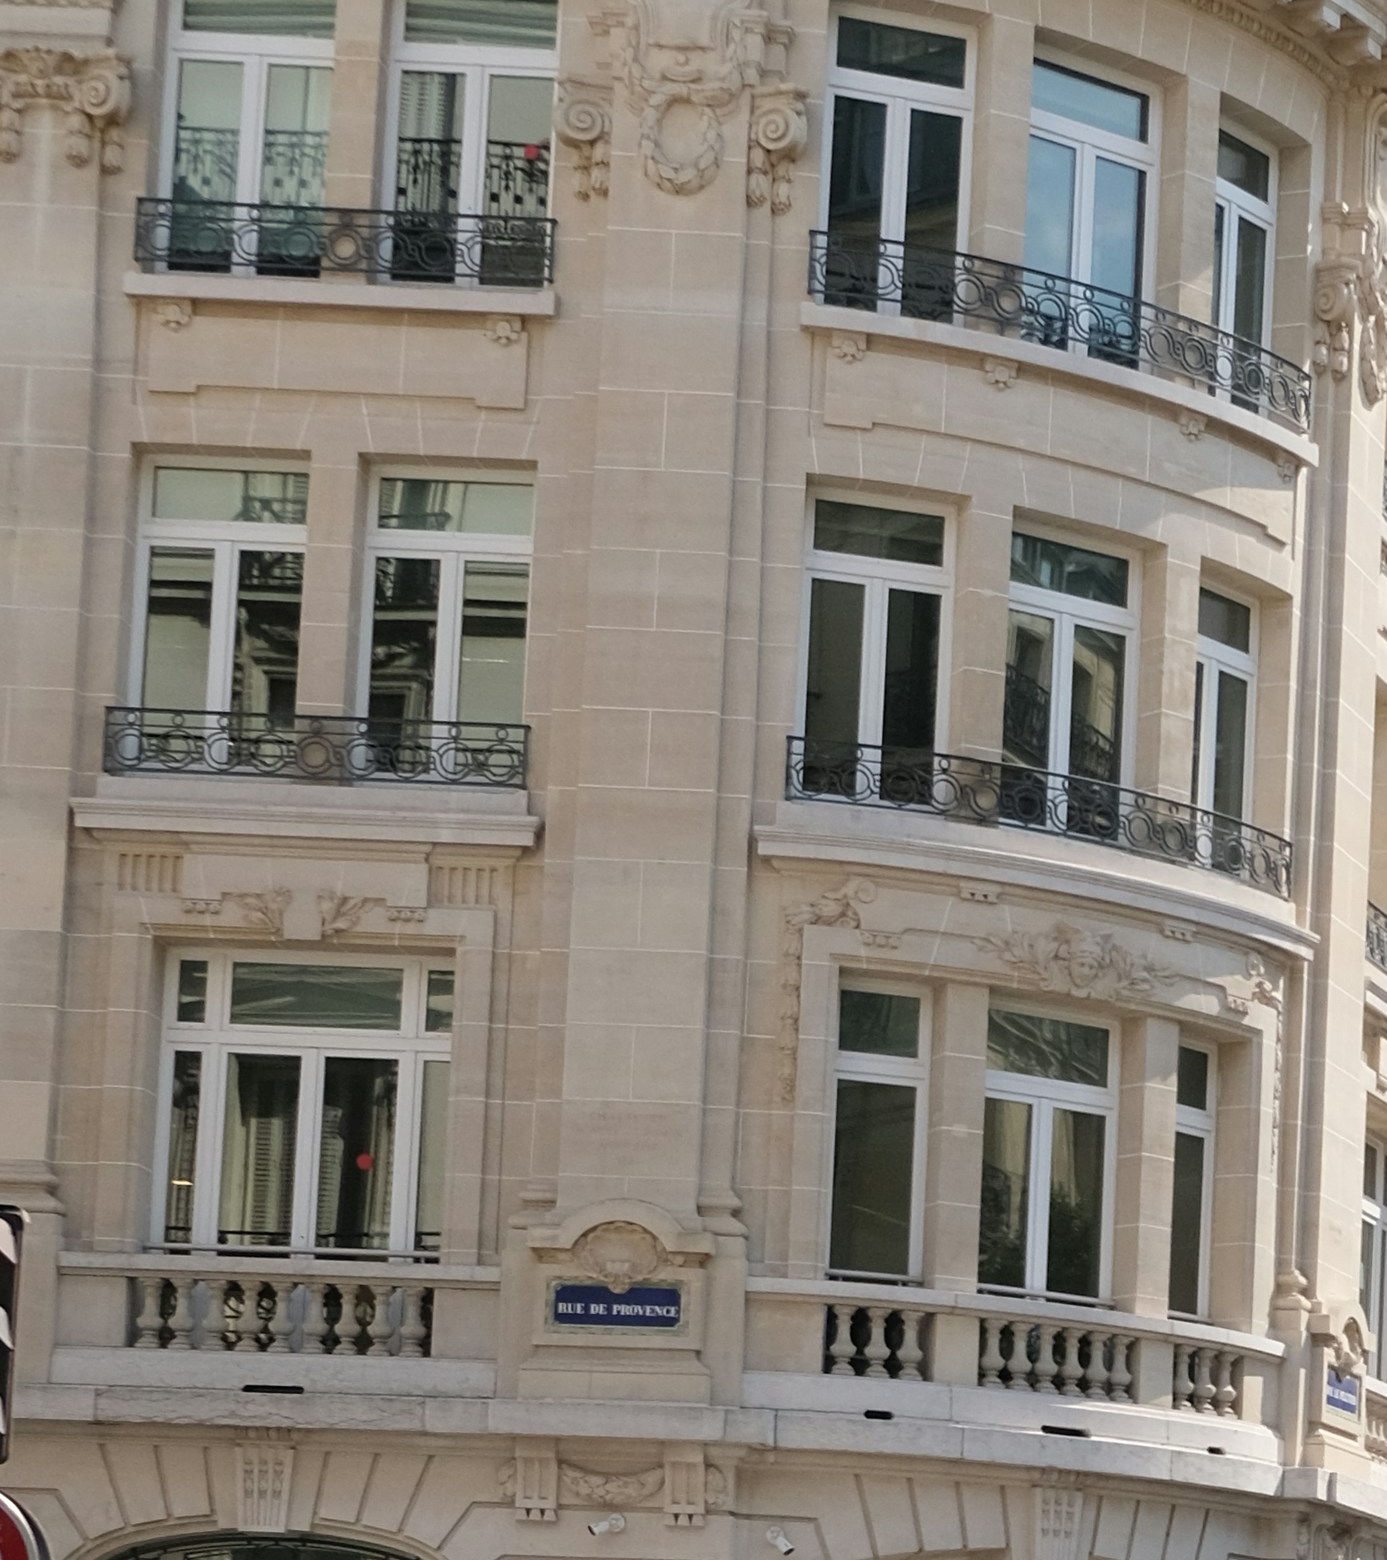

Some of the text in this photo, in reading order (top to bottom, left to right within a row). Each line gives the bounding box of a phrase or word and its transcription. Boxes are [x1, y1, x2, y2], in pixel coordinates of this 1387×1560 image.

[557, 1303, 679, 1317] RUE DE PROVENCE
